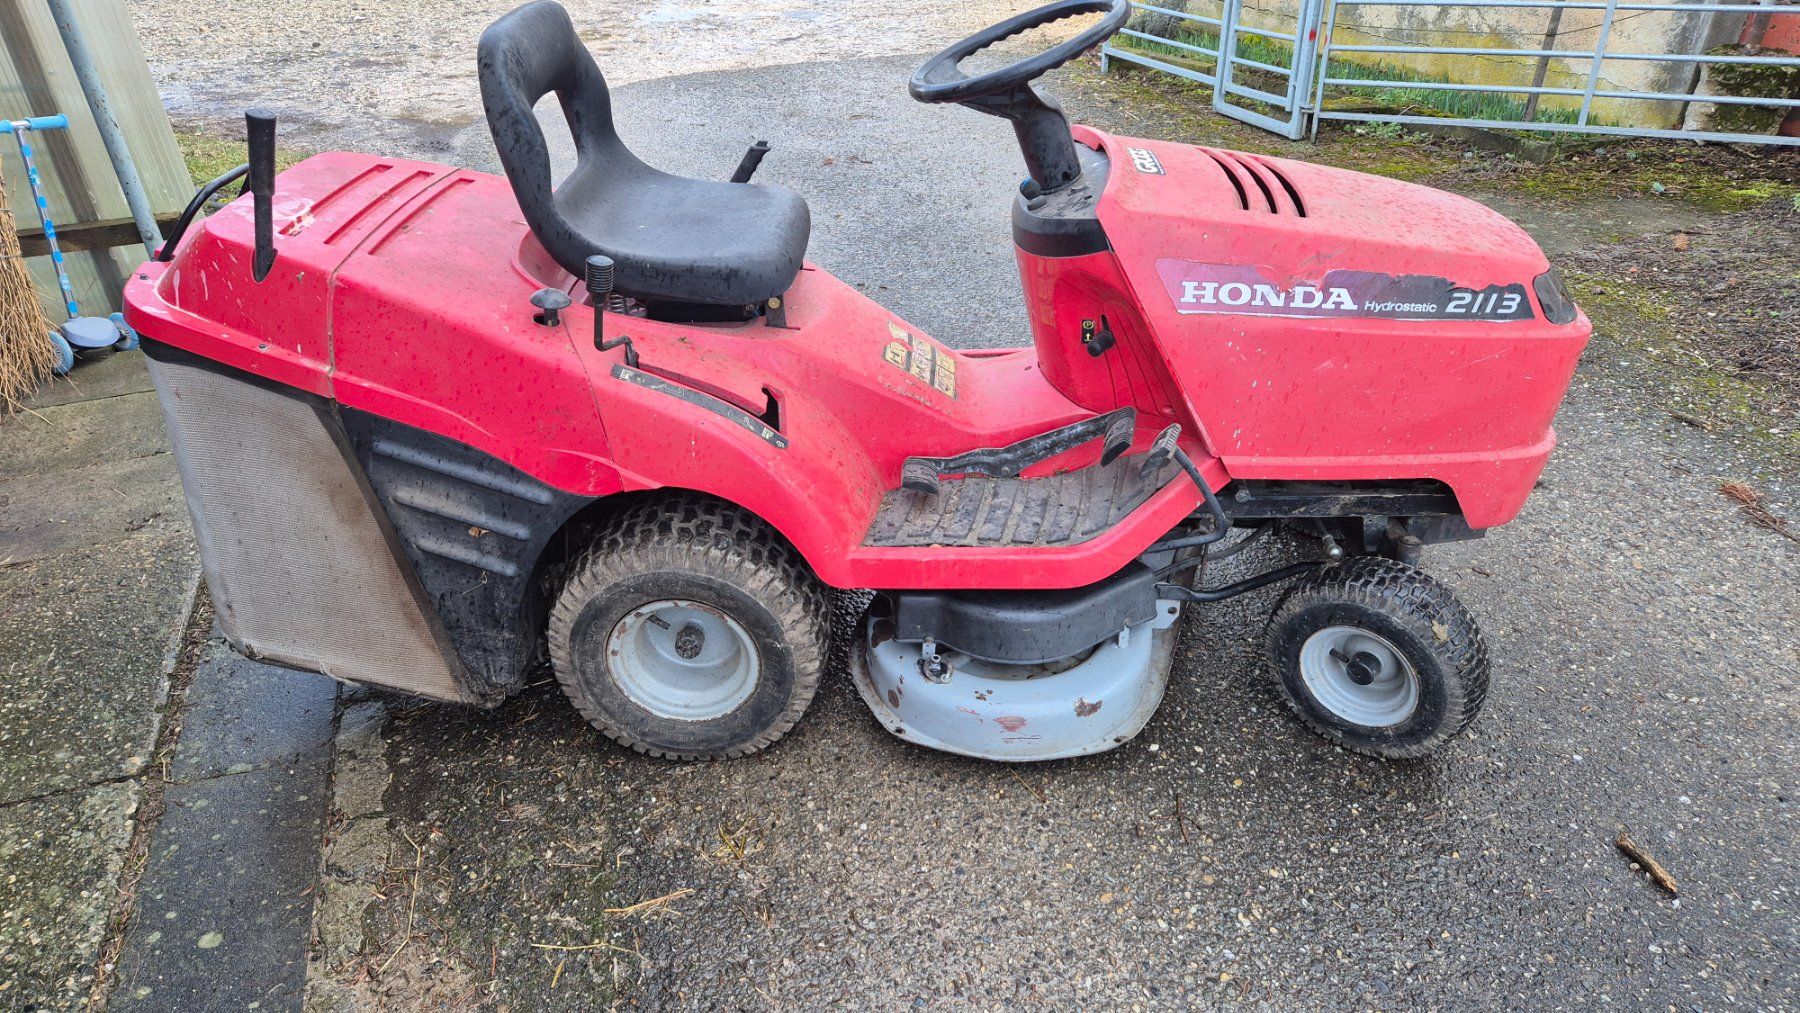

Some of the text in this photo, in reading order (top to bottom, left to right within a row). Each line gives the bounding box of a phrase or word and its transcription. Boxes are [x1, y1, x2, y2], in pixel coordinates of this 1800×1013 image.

[1180, 280, 1522, 313] HONDA Hydrostatic 2113
